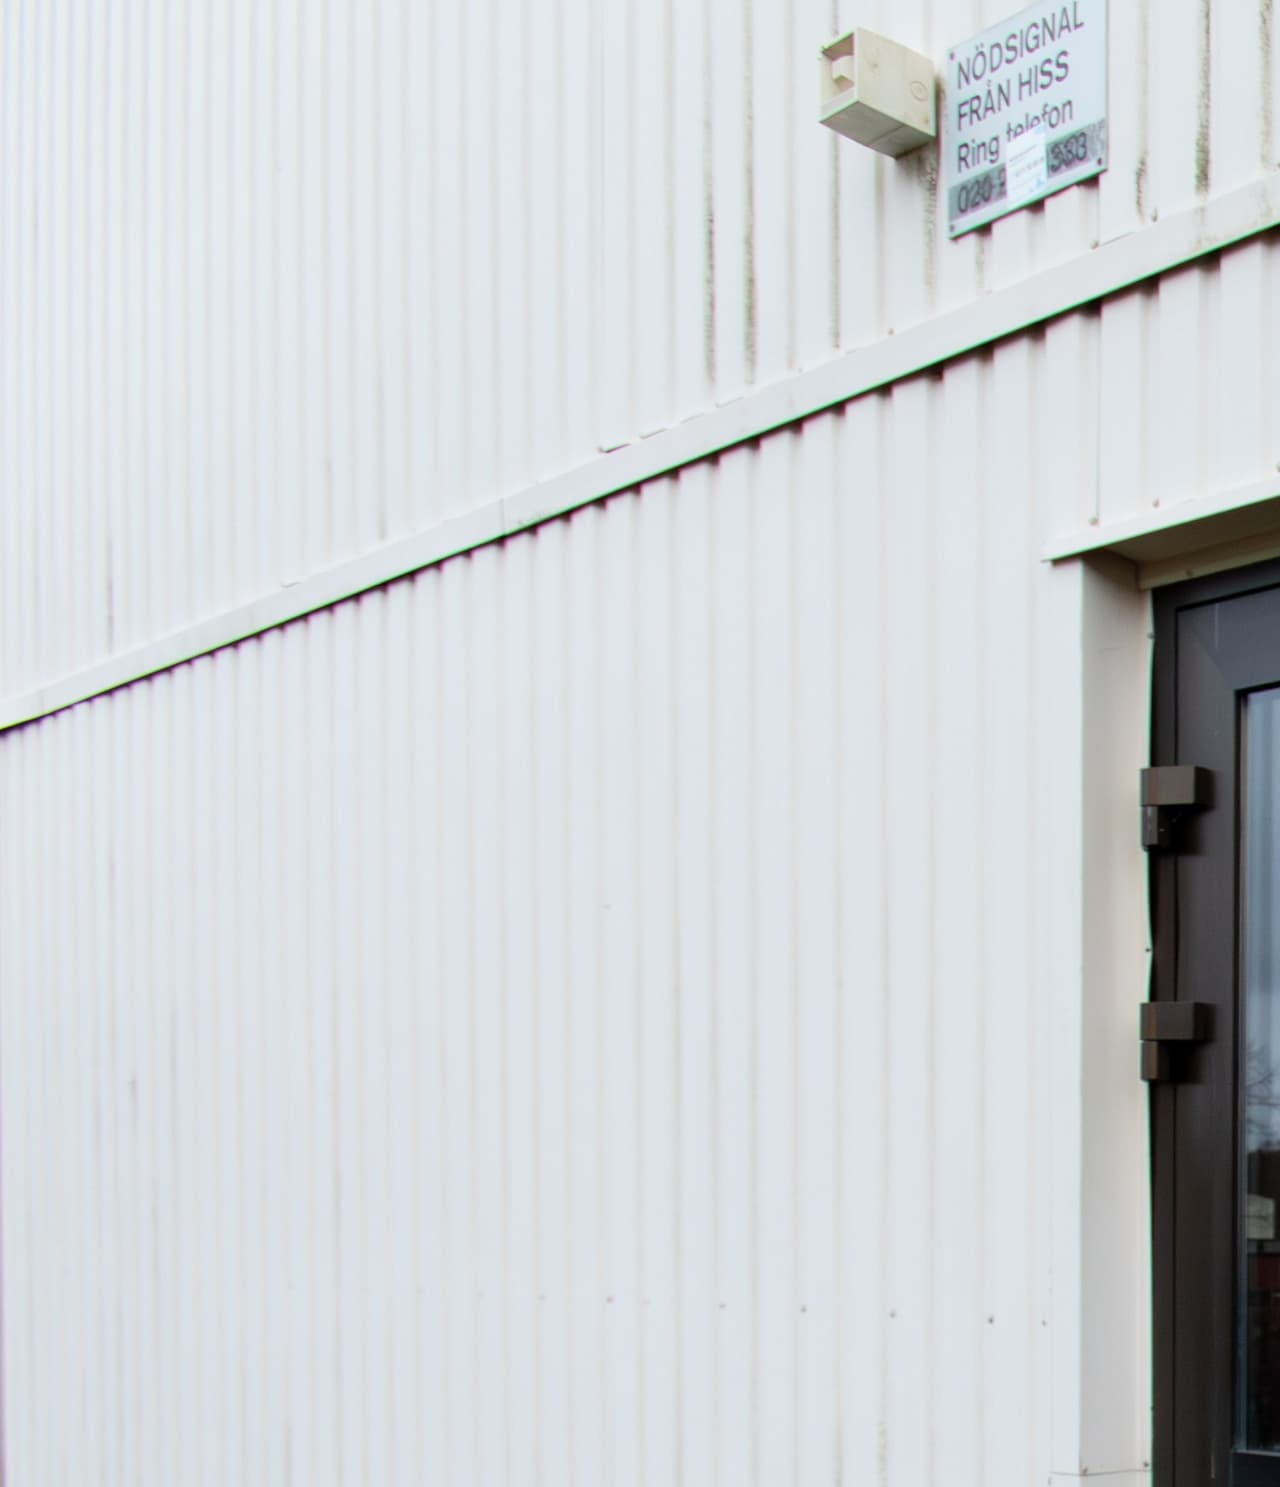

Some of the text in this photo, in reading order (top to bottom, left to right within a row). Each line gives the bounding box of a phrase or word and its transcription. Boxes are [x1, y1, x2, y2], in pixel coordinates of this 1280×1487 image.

[956, 1, 1085, 90] NÖDSIGNAL
[957, 51, 1070, 131] FRÅN HISS
[957, 135, 1001, 173] Ring
